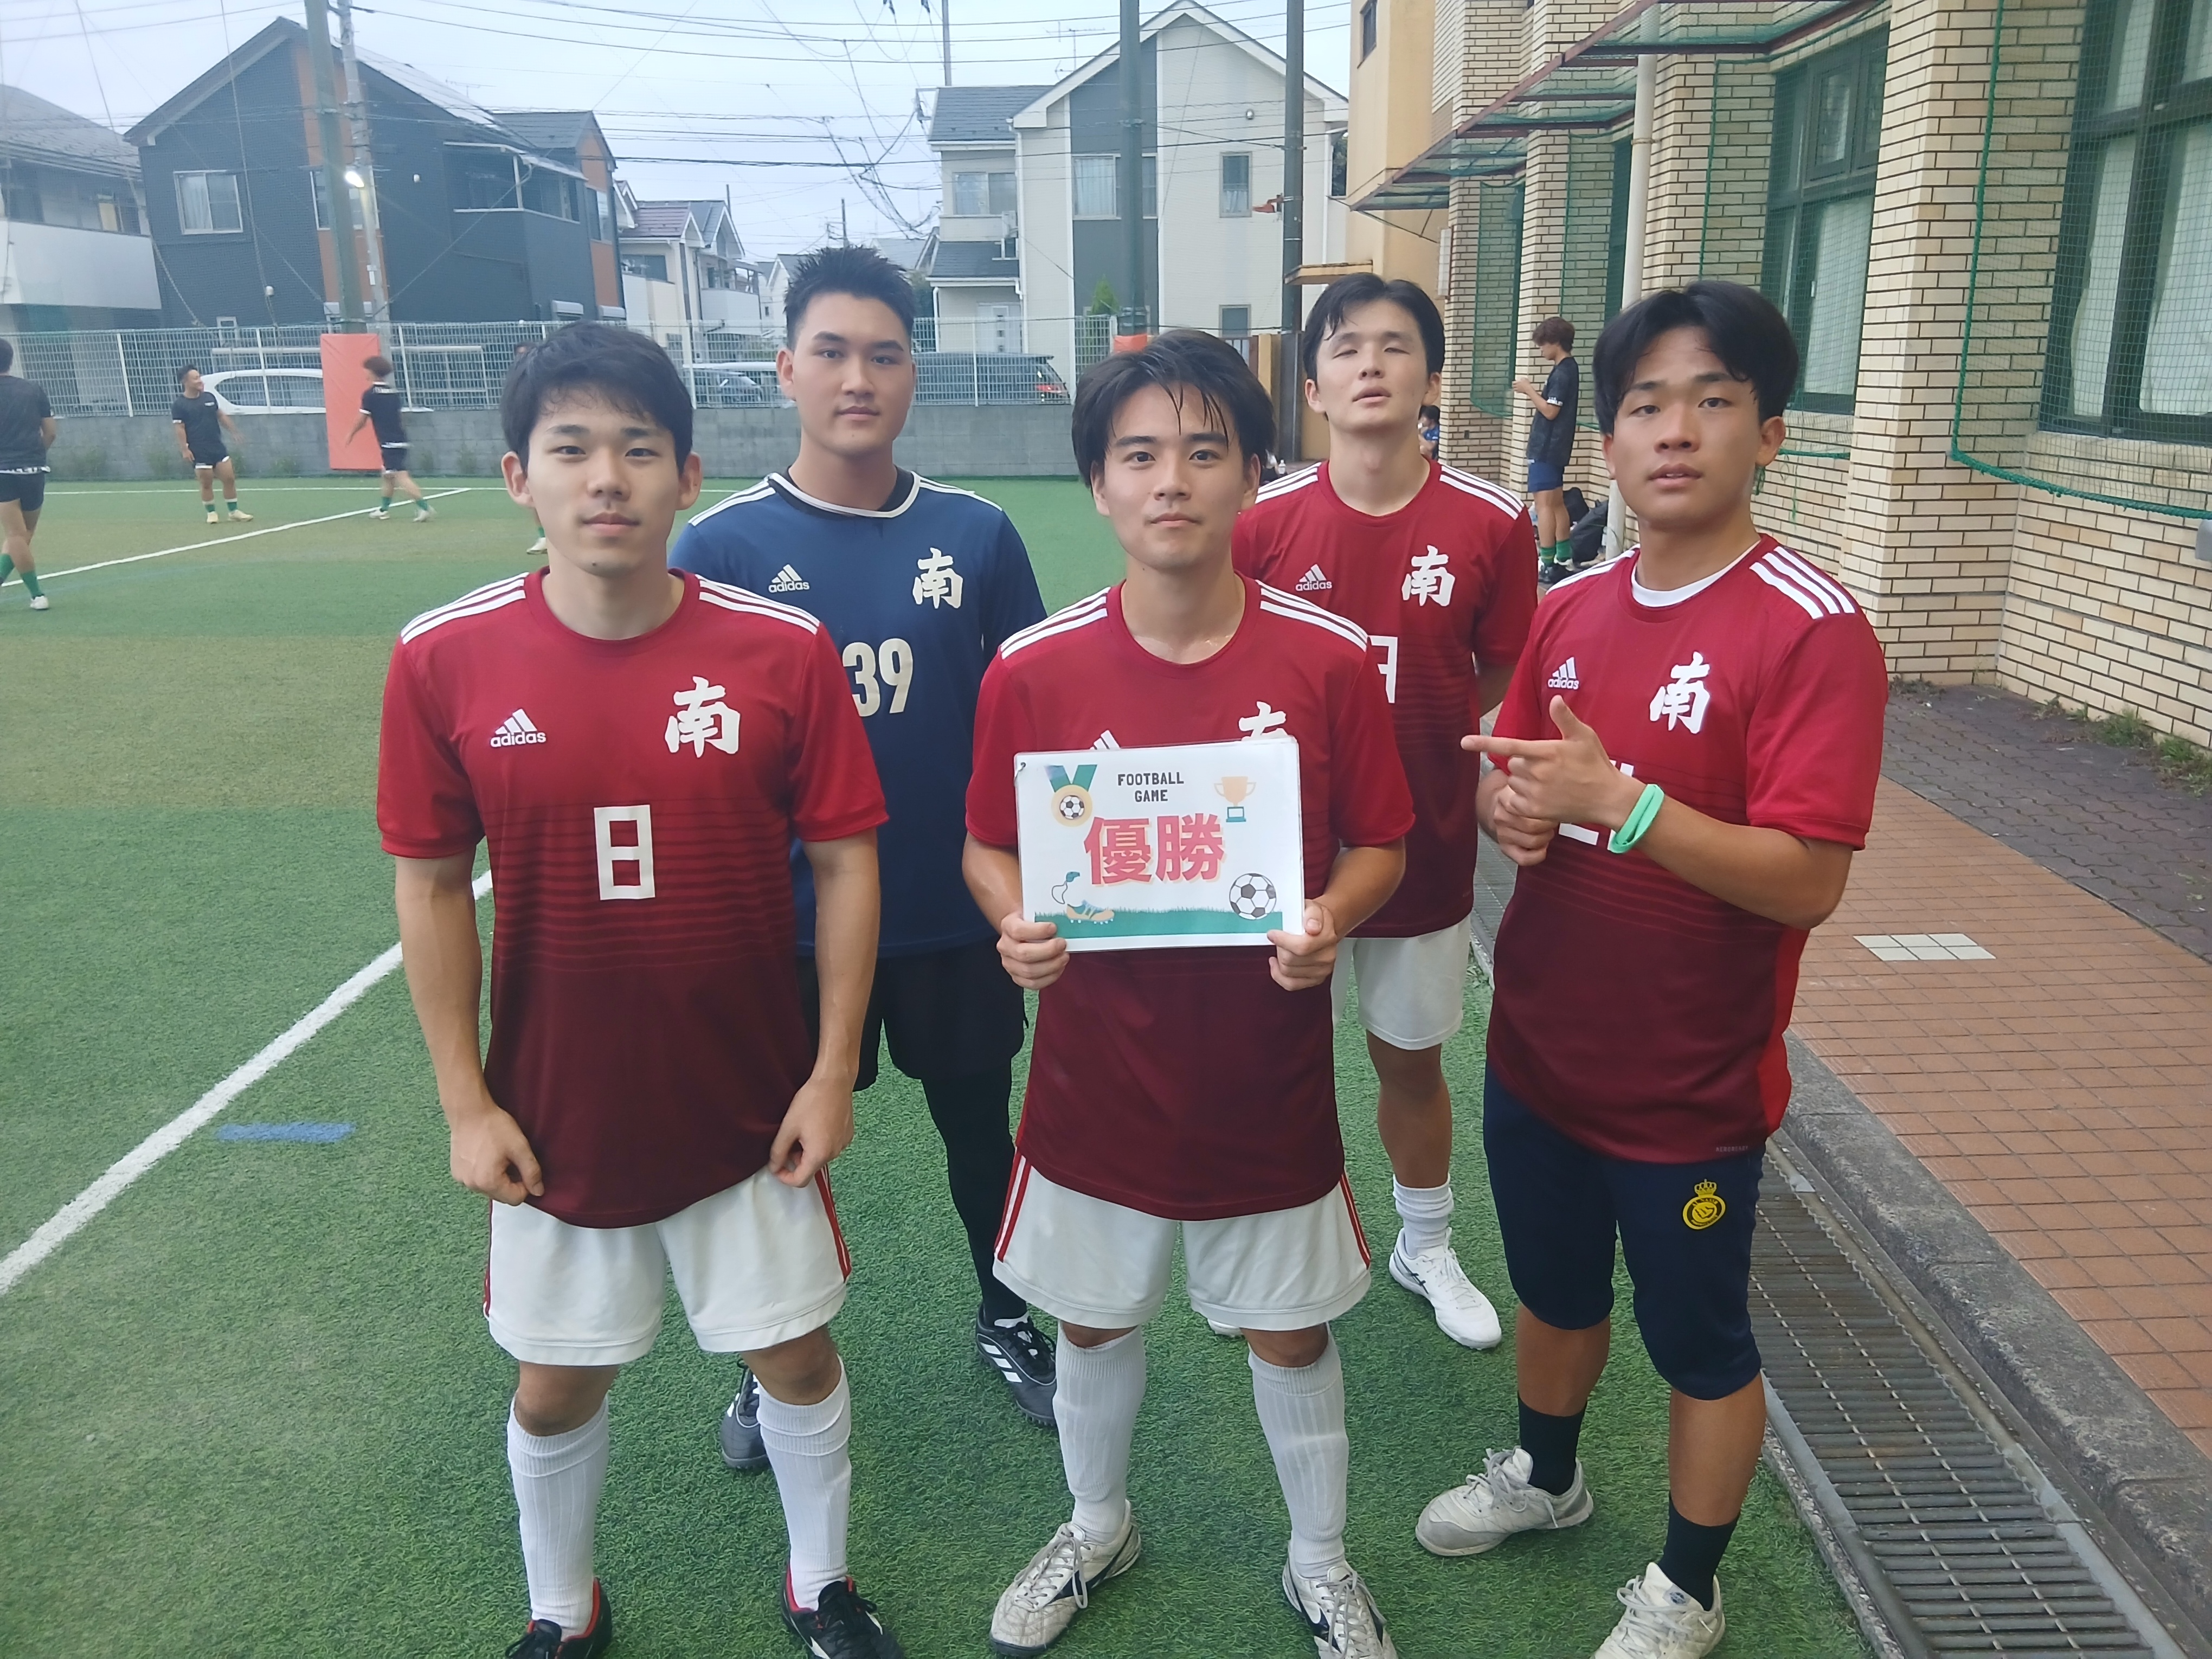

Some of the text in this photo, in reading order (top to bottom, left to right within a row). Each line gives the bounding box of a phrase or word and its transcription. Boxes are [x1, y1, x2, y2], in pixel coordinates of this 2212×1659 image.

[768, 580, 810, 593] adidas
[912, 547, 963, 609] 南
[1295, 579, 1333, 591] adidas
[1402, 545, 1456, 607] 南
[842, 638, 914, 717] 39
[1547, 676, 1580, 690] adidas
[1649, 651, 1711, 734] 南
[490, 730, 546, 748] adidas
[665, 676, 741, 758] 南
[1118, 772, 1184, 786] FOOTBALL
[1134, 789, 1168, 802] GAME
[594, 805, 655, 901] 8
[1084, 813, 1226, 886] 優勝
